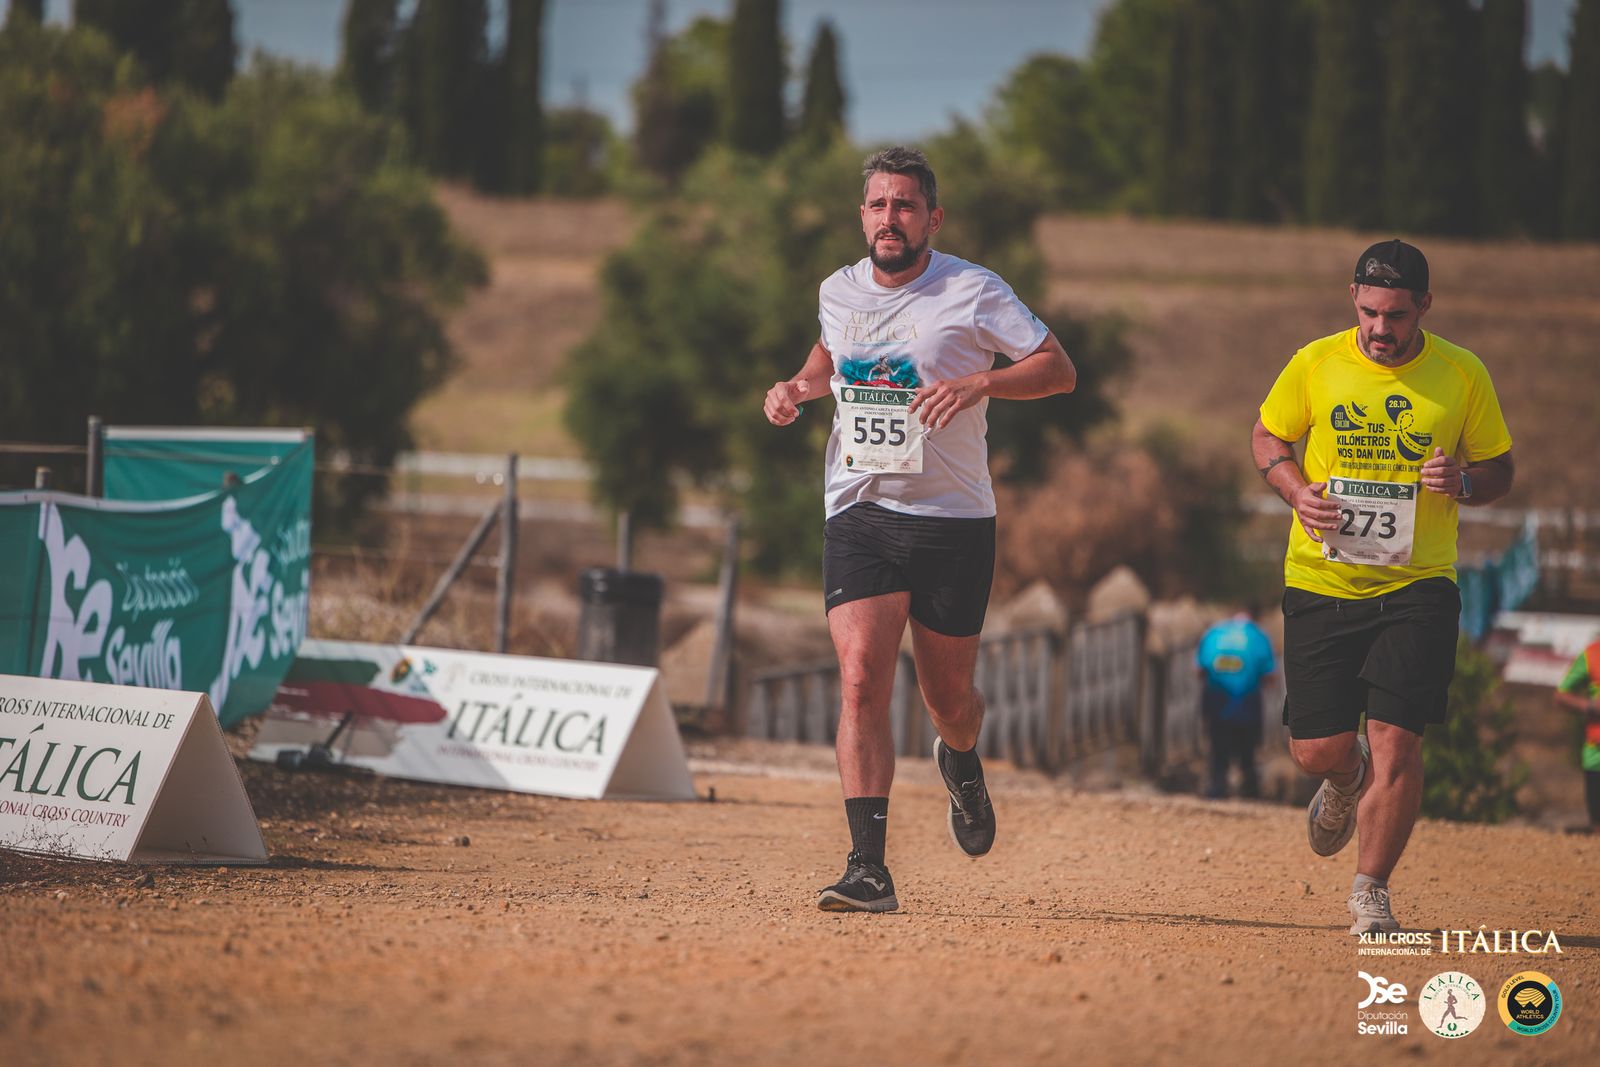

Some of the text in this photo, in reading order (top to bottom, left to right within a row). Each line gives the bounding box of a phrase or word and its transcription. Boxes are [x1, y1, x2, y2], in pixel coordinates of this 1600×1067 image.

[859, 391, 900, 402] ITÁLICA
[1389, 400, 1407, 408] 26.10
[853, 416, 906, 446] 555
[1367, 423, 1385, 433] TUS
[1336, 433, 1390, 446] KILÓMETROS
[1338, 448, 1396, 460] NOS DAN VIDA
[1348, 483, 1391, 496] ITÁLICA
[1339, 508, 1397, 539] 273
[32, 700, 148, 727] INTERNACIONAL
[152, 712, 175, 730] DE
[446, 693, 609, 756] ITÁLICA
[32, 804, 71, 821] CROSS
[71, 809, 131, 828] COUNTRY
